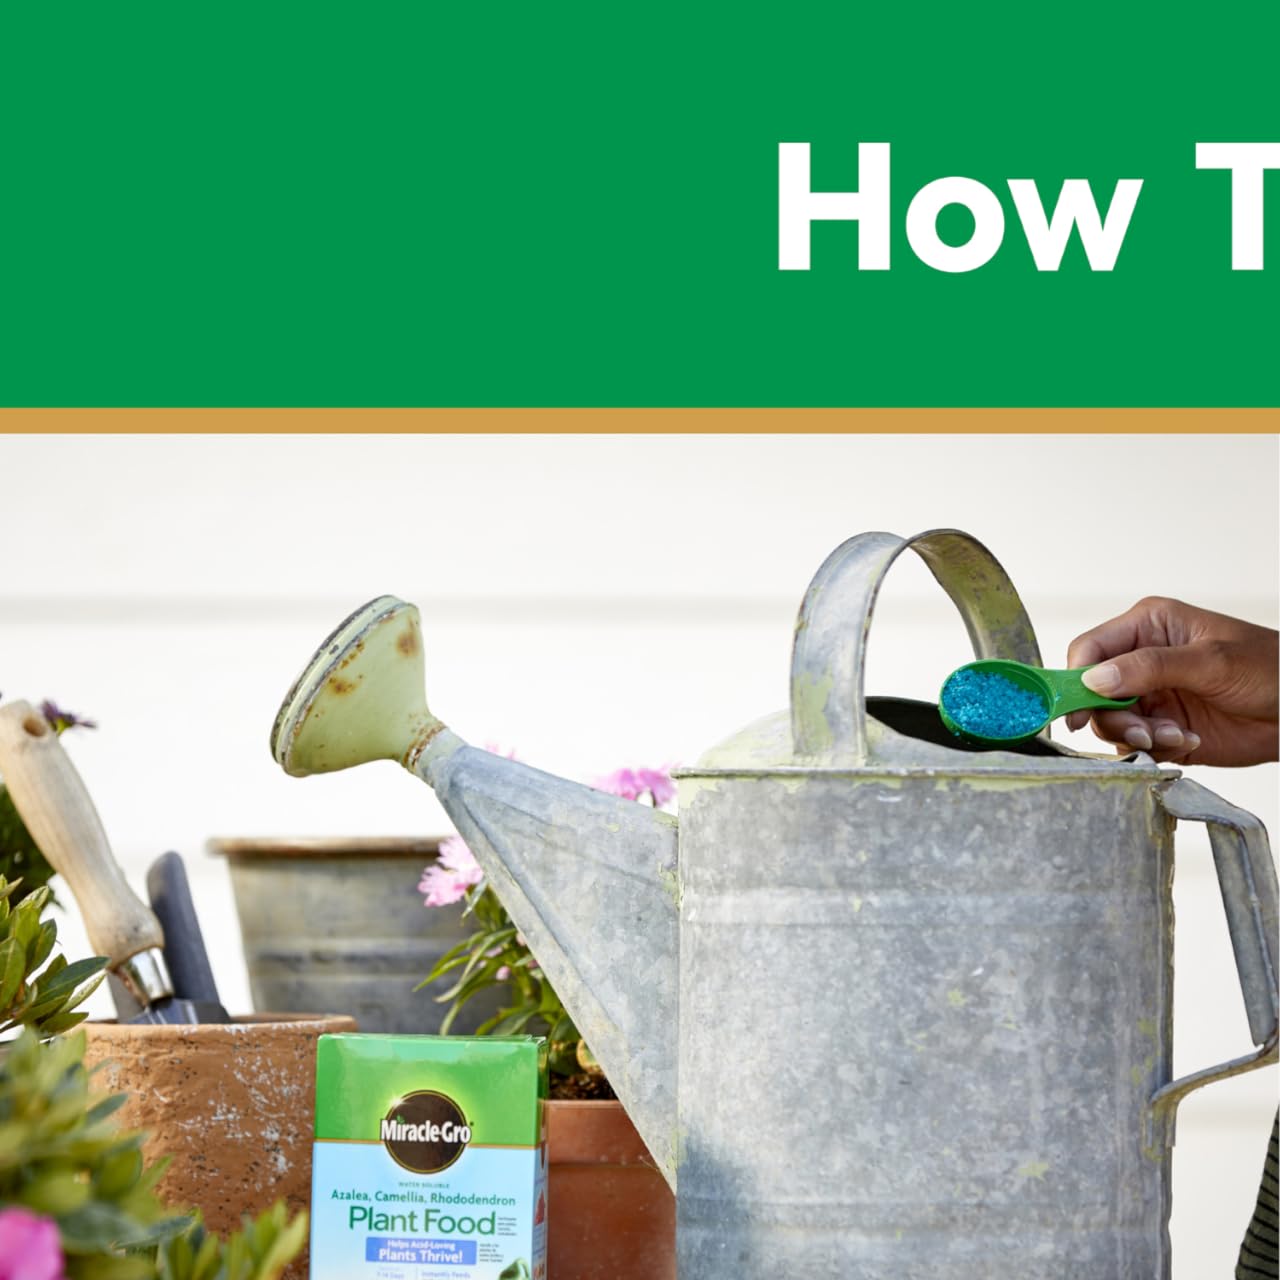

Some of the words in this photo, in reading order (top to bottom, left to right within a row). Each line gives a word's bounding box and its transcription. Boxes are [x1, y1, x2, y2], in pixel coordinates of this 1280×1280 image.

[331, 1188, 372, 1203] Azalea,
[375, 1190, 427, 1204] Camellia,
[430, 1192, 516, 1207] Rhododendron
[349, 1205, 418, 1233] Plant
[425, 1209, 496, 1235] Food
[379, 1248, 416, 1262] Plants
[420, 1250, 463, 1263] Thrive!
